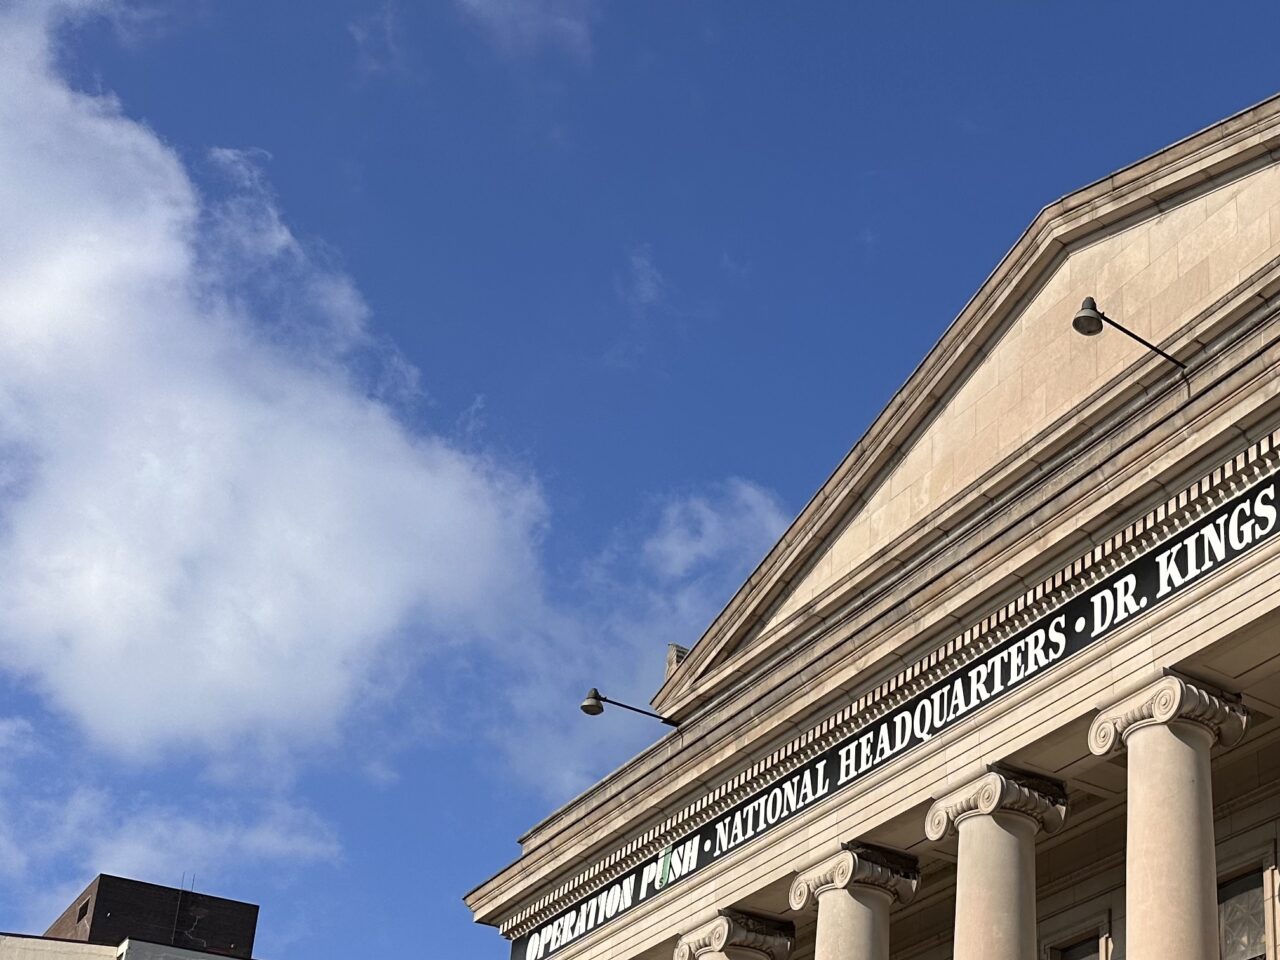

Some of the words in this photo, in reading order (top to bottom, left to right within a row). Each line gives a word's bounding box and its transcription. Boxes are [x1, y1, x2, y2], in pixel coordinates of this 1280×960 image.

[639, 834, 701, 901] PUSH
[713, 759, 830, 858] NATIONAL
[837, 614, 1067, 786] HEADQUARTERS
[1090, 574, 1148, 638] DR.
[1156, 483, 1278, 599] KINGS
